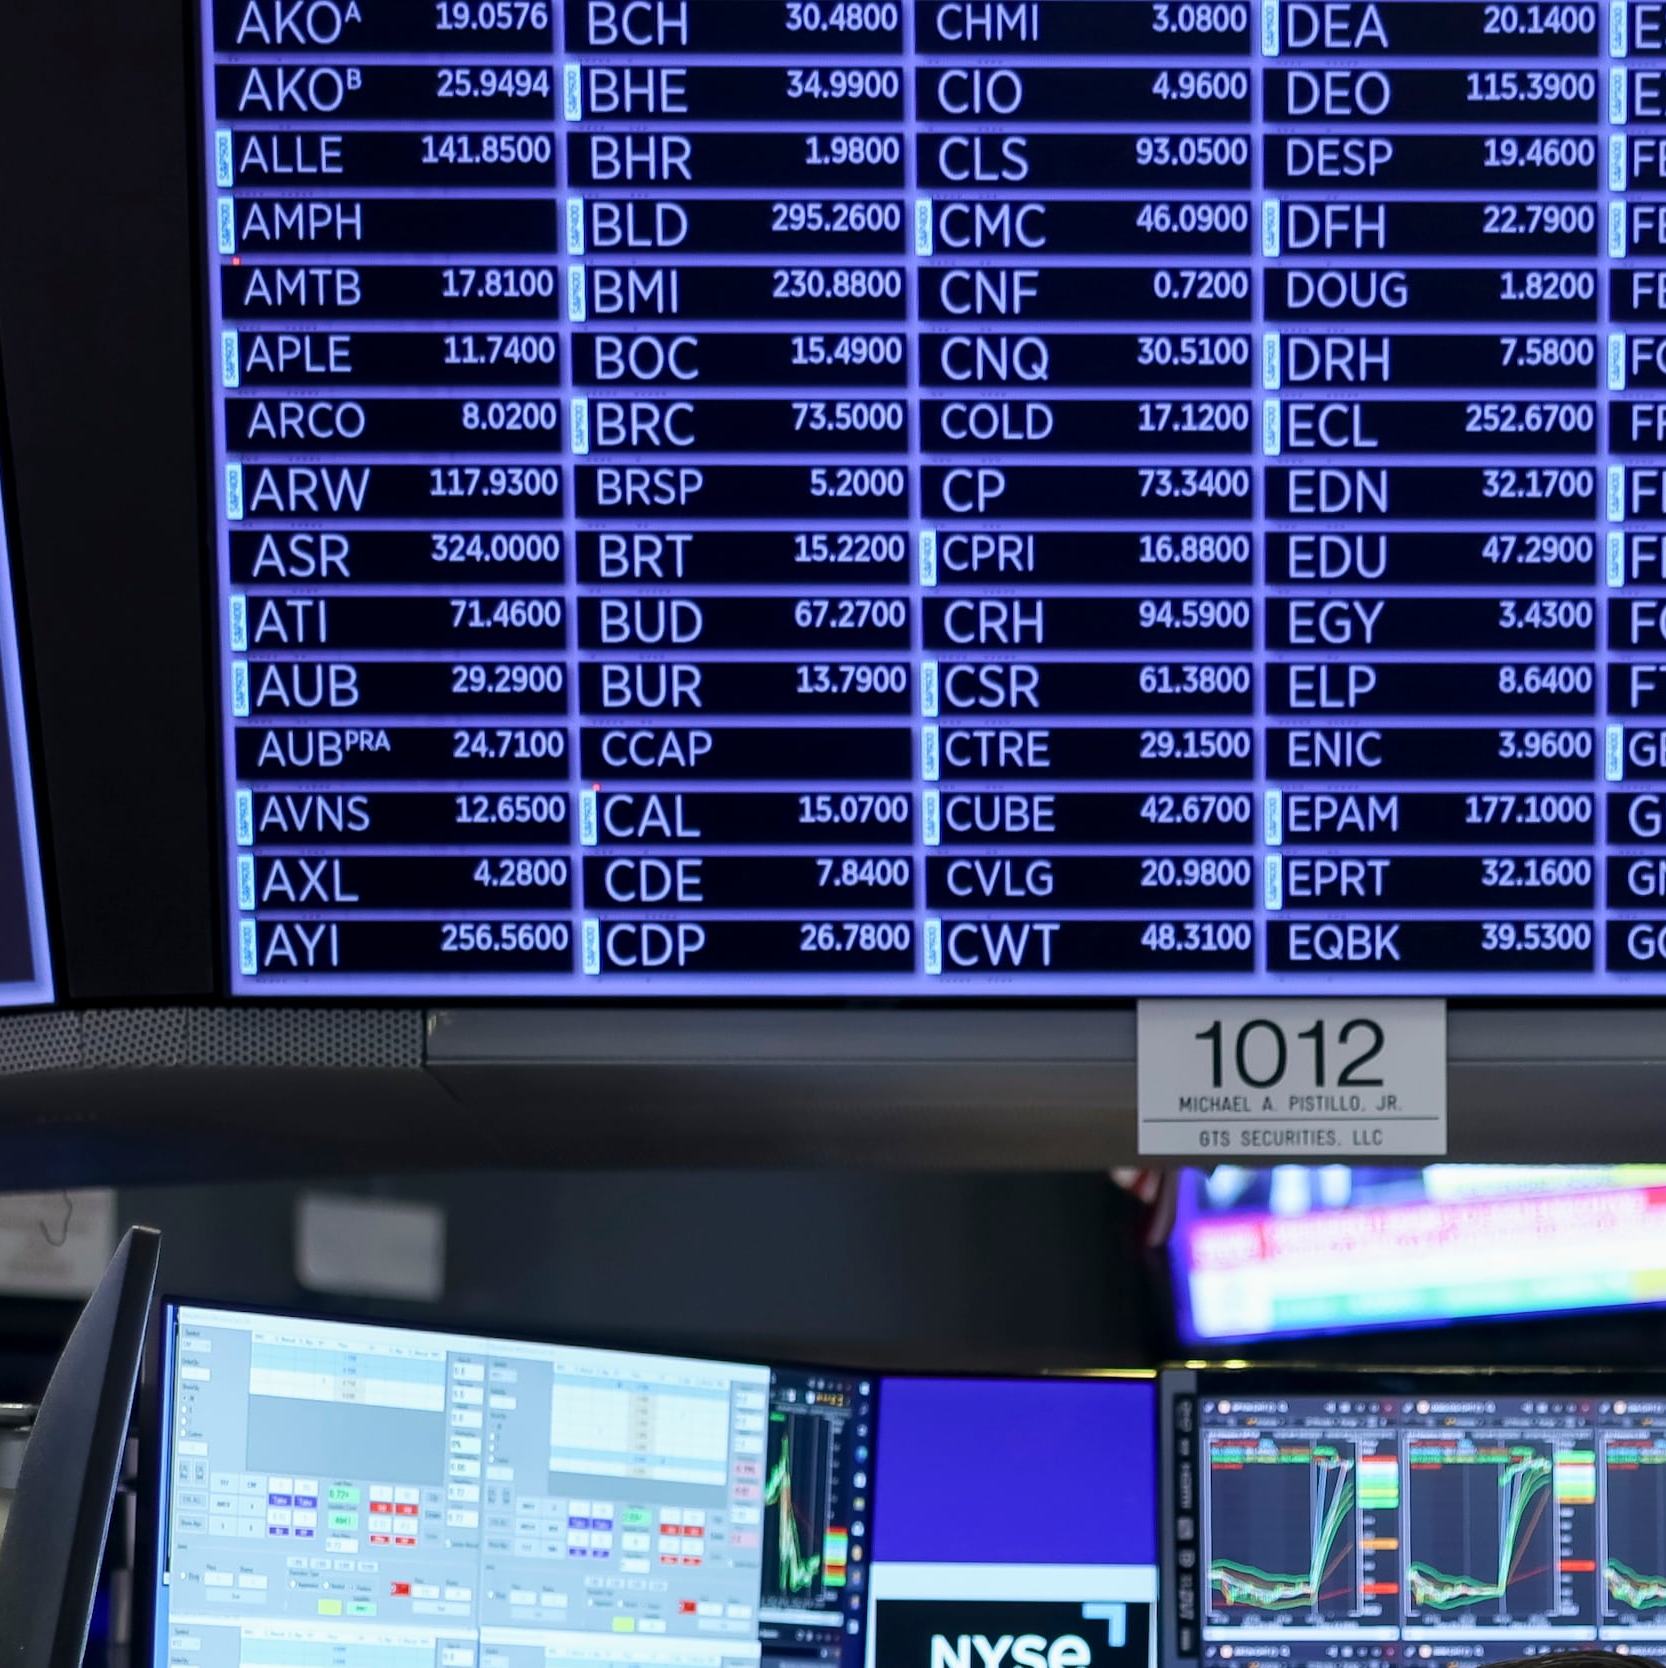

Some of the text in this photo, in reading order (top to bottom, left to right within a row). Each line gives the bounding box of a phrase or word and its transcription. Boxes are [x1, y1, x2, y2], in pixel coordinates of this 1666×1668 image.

[936, 2, 1248, 42] CHMI 3.0800
[1287, 70, 1596, 116] DEO 115.3900
[590, 134, 901, 181] BHR 1.9800
[1286, 137, 1596, 177] DESP 19.4600
[591, 201, 689, 247] BLD
[771, 201, 902, 232] 295.2600
[939, 268, 1249, 315] CNF 0.7200
[245, 334, 556, 373] APLE 11.7400
[940, 335, 1250, 381] CNQ 30.5100
[247, 400, 558, 439] ARCO 8.0200
[1287, 402, 1595, 448] ECL 252.6700
[596, 466, 905, 506] BRSP 5.2000
[1288, 468, 1595, 513] EDN 32.1700
[598, 532, 906, 578] BRT 15.2200
[943, 599, 1251, 644] CRH 94.5900
[256, 663, 564, 708] AUB 29.2900
[944, 664, 1251, 708] CSR 61.3800
[1288, 729, 1593, 768] ENIC 3.9600
[603, 794, 909, 838] CAL 15.0700
[1288, 794, 1593, 832] EPAM 177.1000
[604, 857, 910, 902] CDE 7.8400
[947, 922, 1252, 967] CWT 48.3100
[1195, 1018, 1385, 1089] 1012
[1179, 1096, 1249, 1113] MICHAEL
[1199, 1130, 1230, 1147] GTS
[1352, 1128, 1383, 1146] LLC
